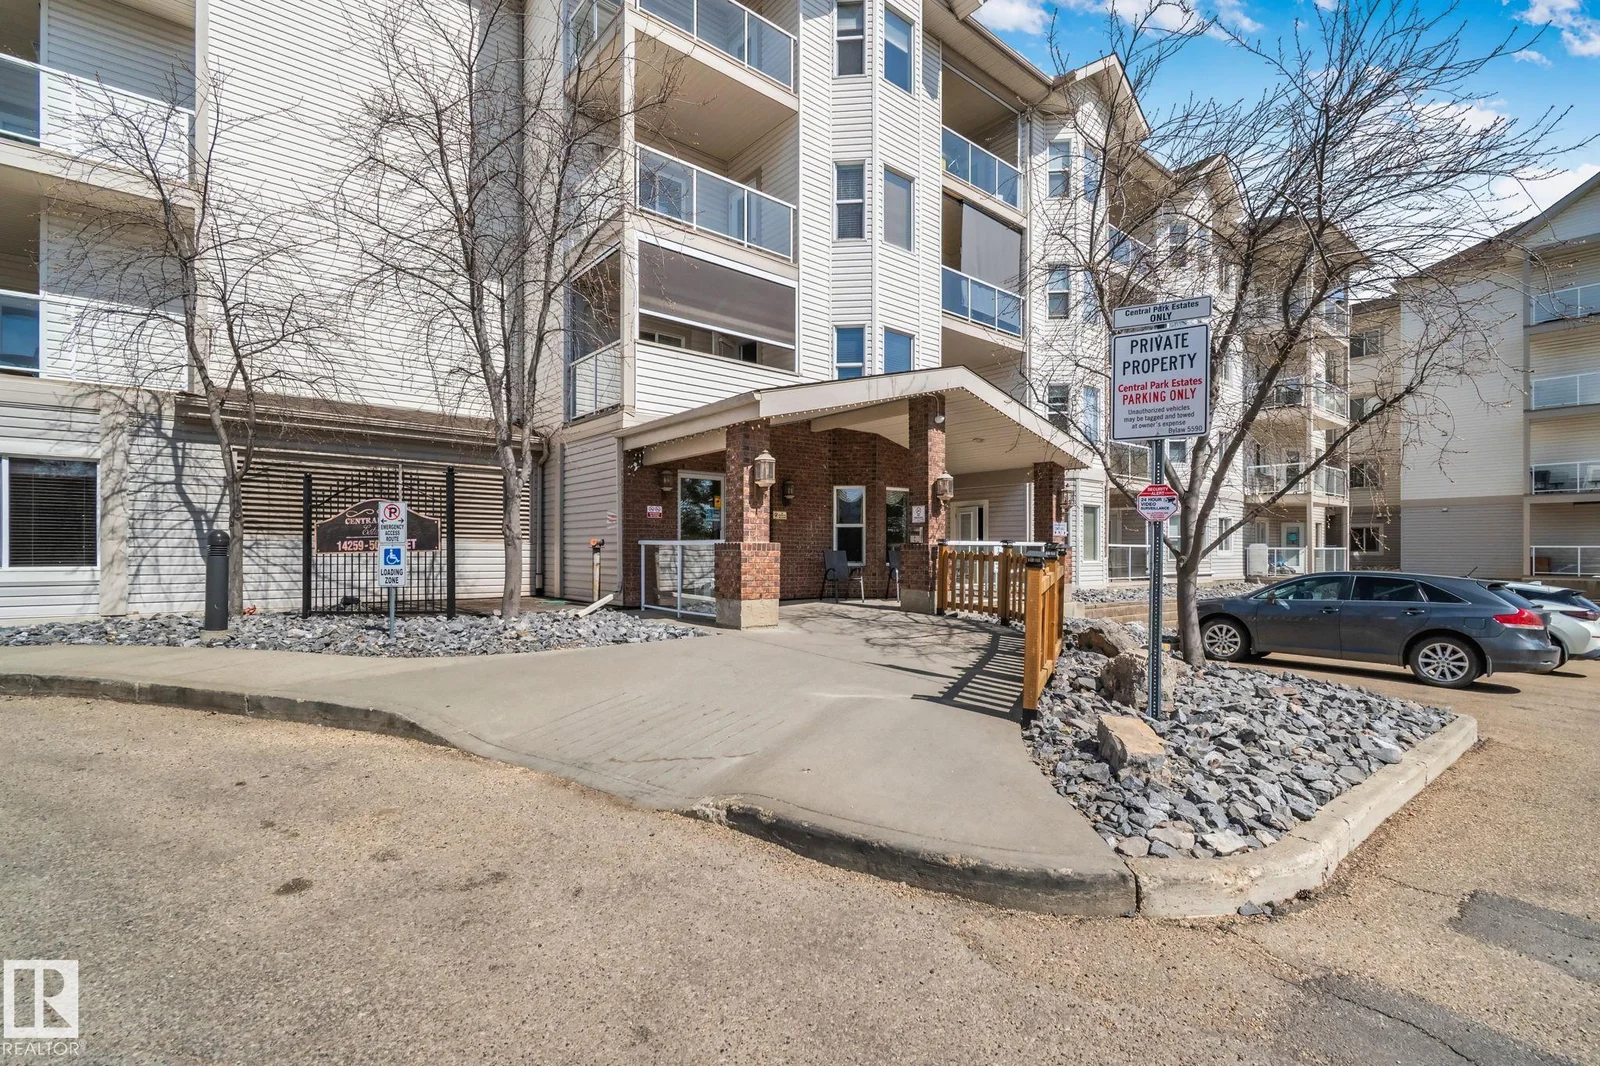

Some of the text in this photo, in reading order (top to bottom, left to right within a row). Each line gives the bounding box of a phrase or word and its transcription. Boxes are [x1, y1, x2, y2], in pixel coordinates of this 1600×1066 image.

[1125, 301, 1199, 317] Central Park Estates
[1150, 312, 1172, 322] ONLY
[1130, 332, 1189, 354] PRIVATE
[1123, 353, 1197, 376] PROPERTY
[1118, 377, 1202, 392] Central Park Estates
[1122, 388, 1197, 405] PARKING ONLY
[1128, 407, 1165, 415] Unauthorized
